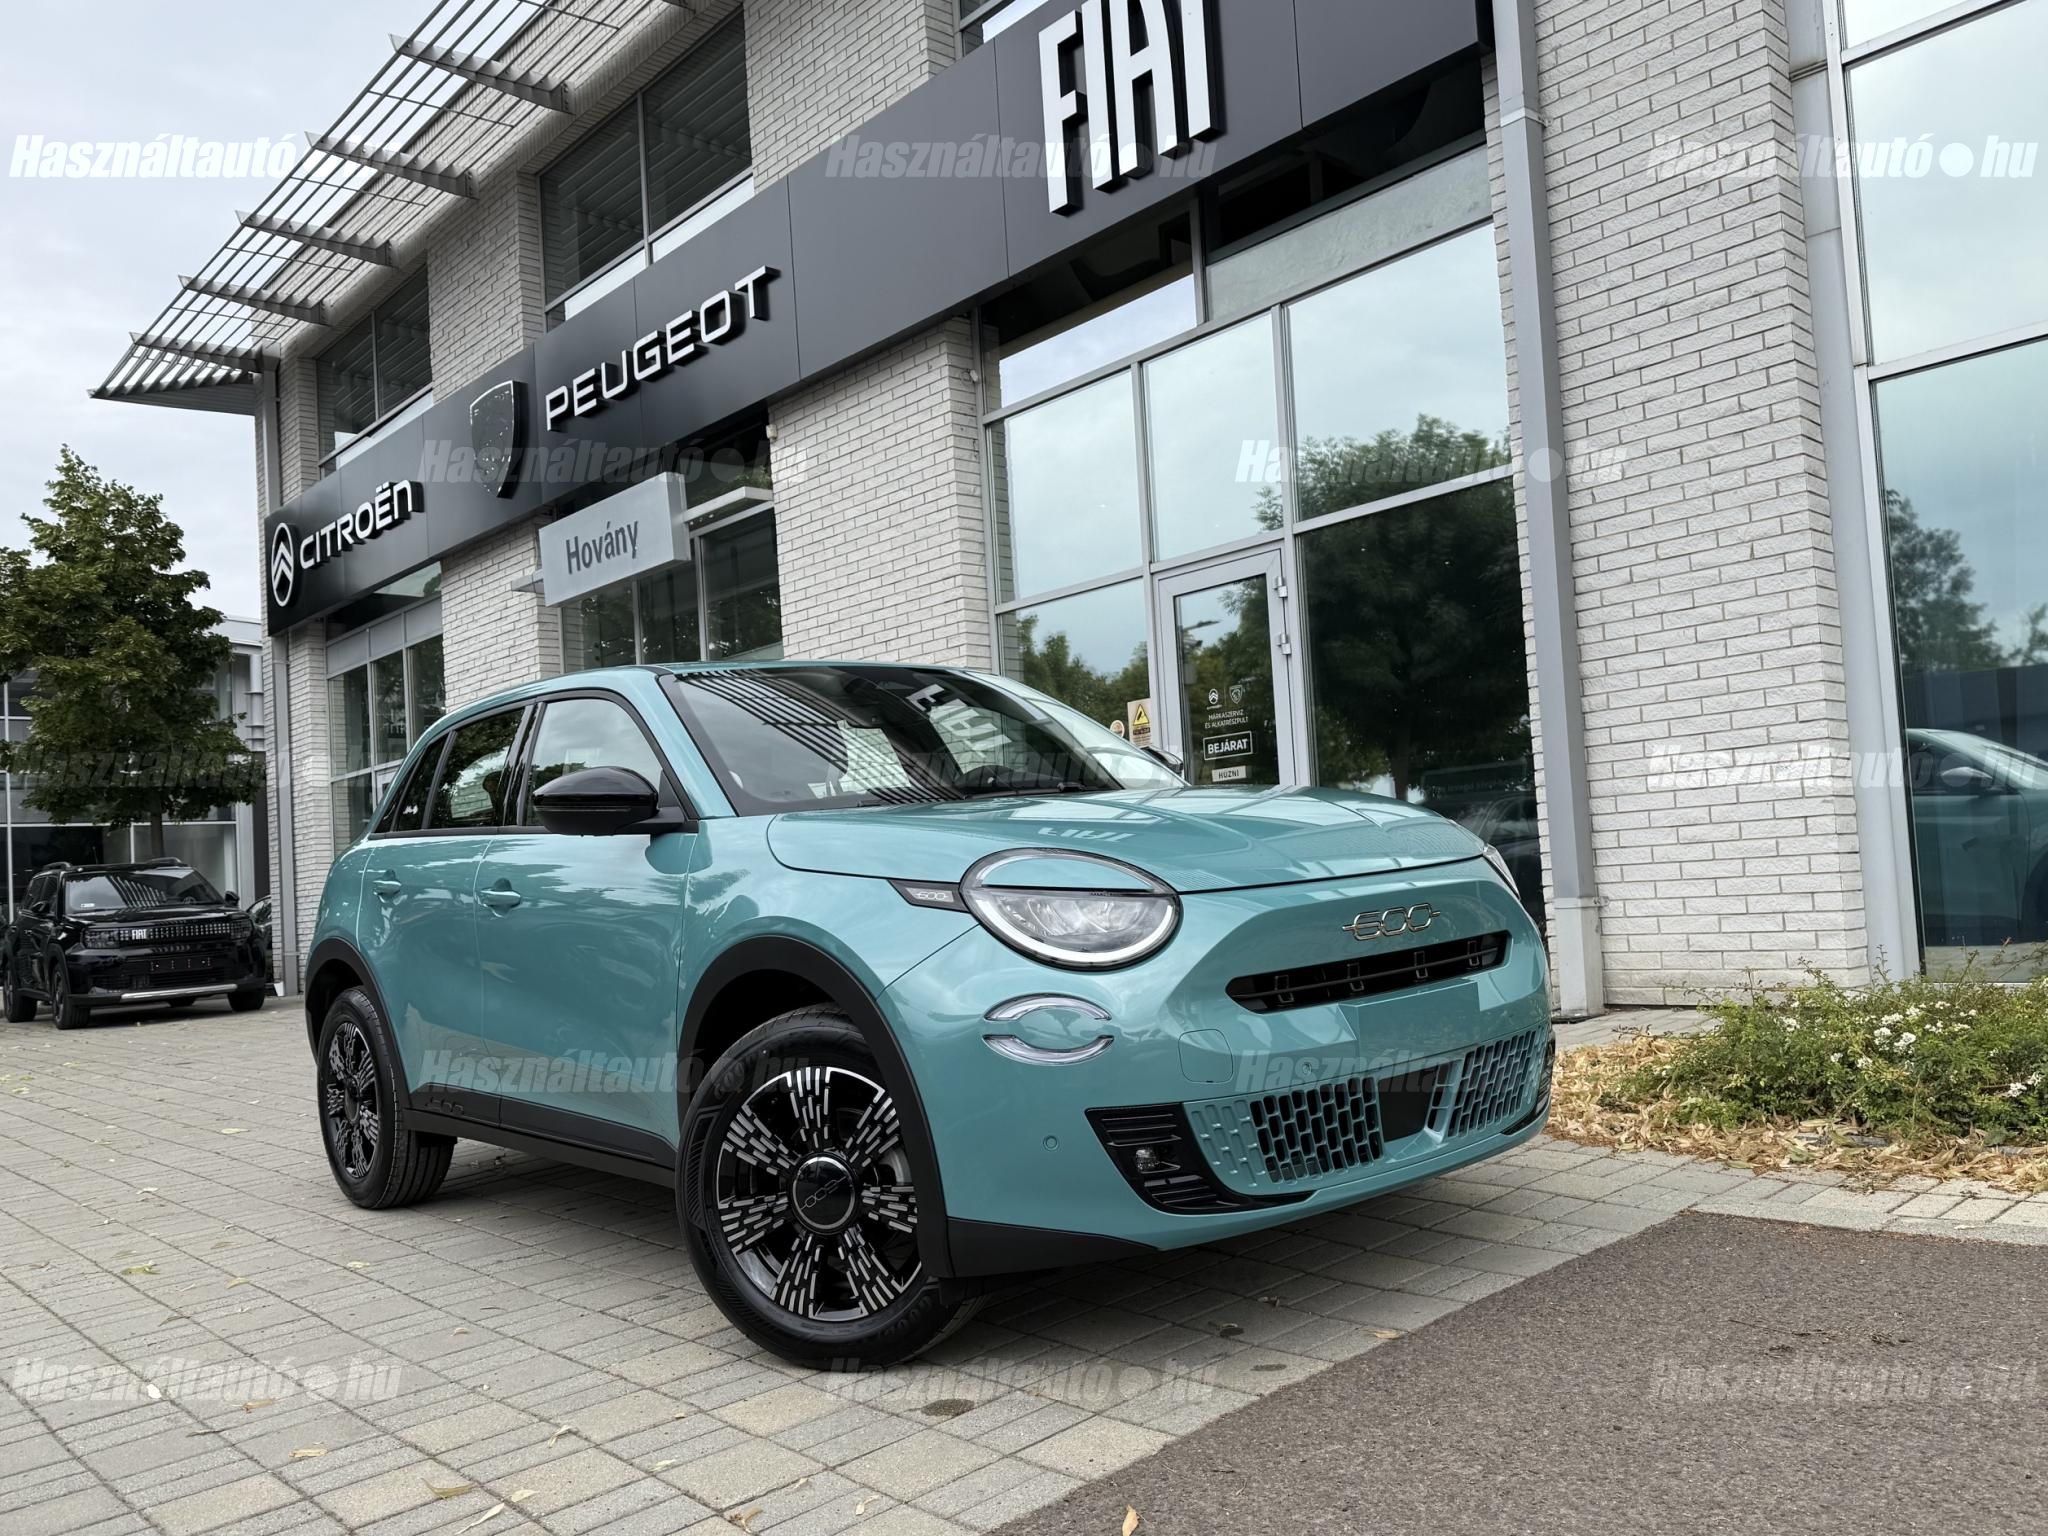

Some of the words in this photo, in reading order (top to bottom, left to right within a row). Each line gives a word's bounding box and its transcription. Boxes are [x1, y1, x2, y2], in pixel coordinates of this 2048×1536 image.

[546, 265, 777, 431] PEUGEOT
[566, 520, 639, 575] Hovány
[1207, 738, 1249, 755] BEJÁRAT
[131, 928, 147, 940] FIAT
[1353, 903, 1433, 941] 600
